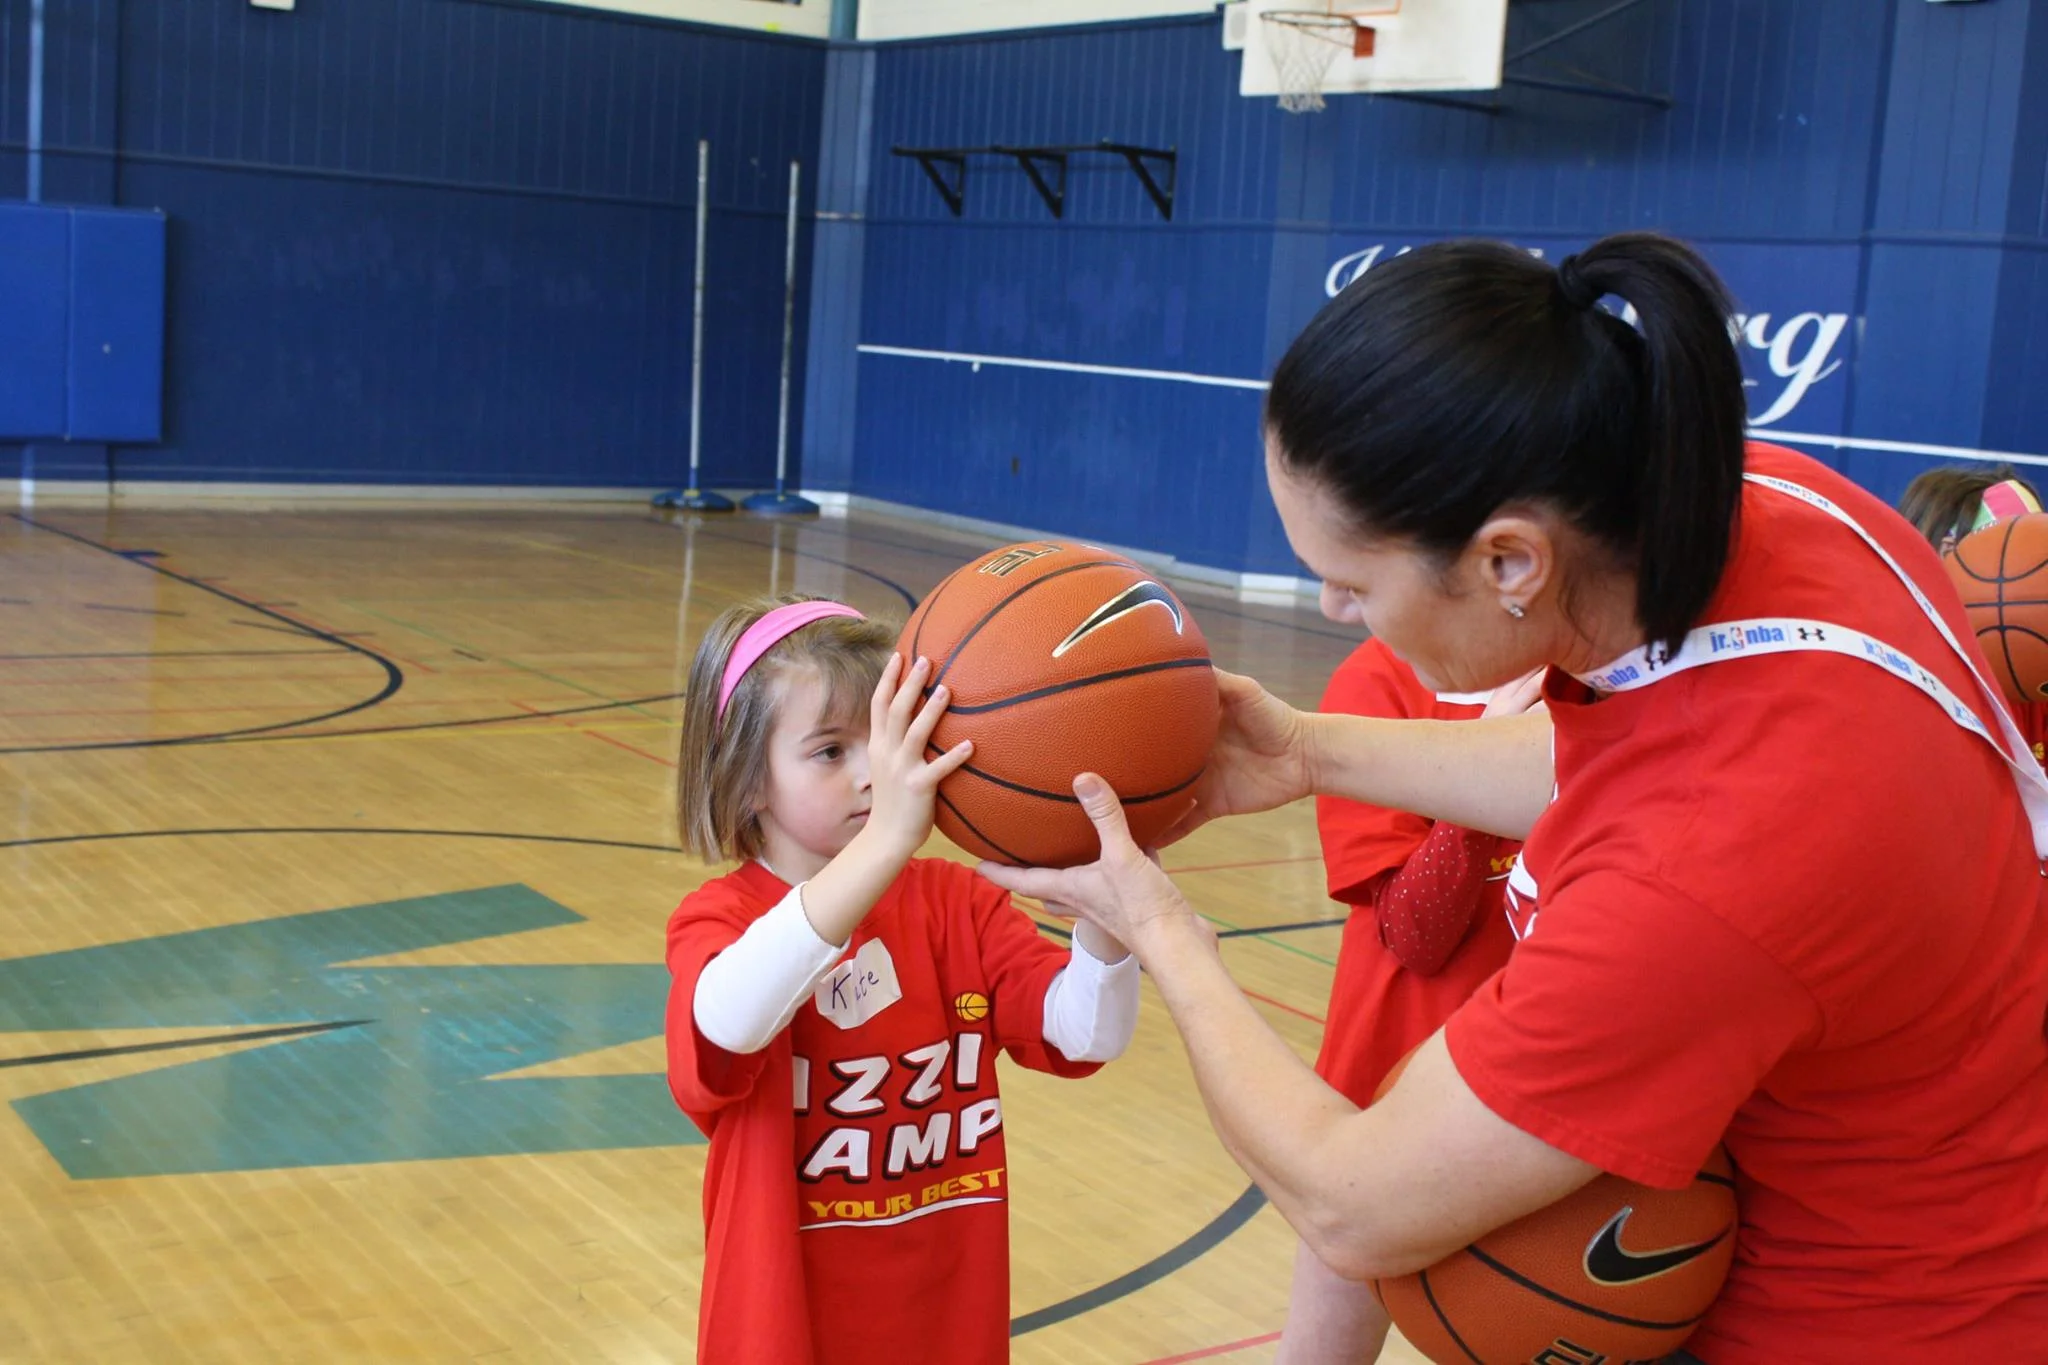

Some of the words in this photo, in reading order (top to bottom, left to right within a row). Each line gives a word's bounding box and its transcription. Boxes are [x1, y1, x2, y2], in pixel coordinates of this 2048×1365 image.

[1745, 625, 1784, 645] nba
[808, 1193, 914, 1218] YOUR
[921, 1167, 1005, 1206] BEST
